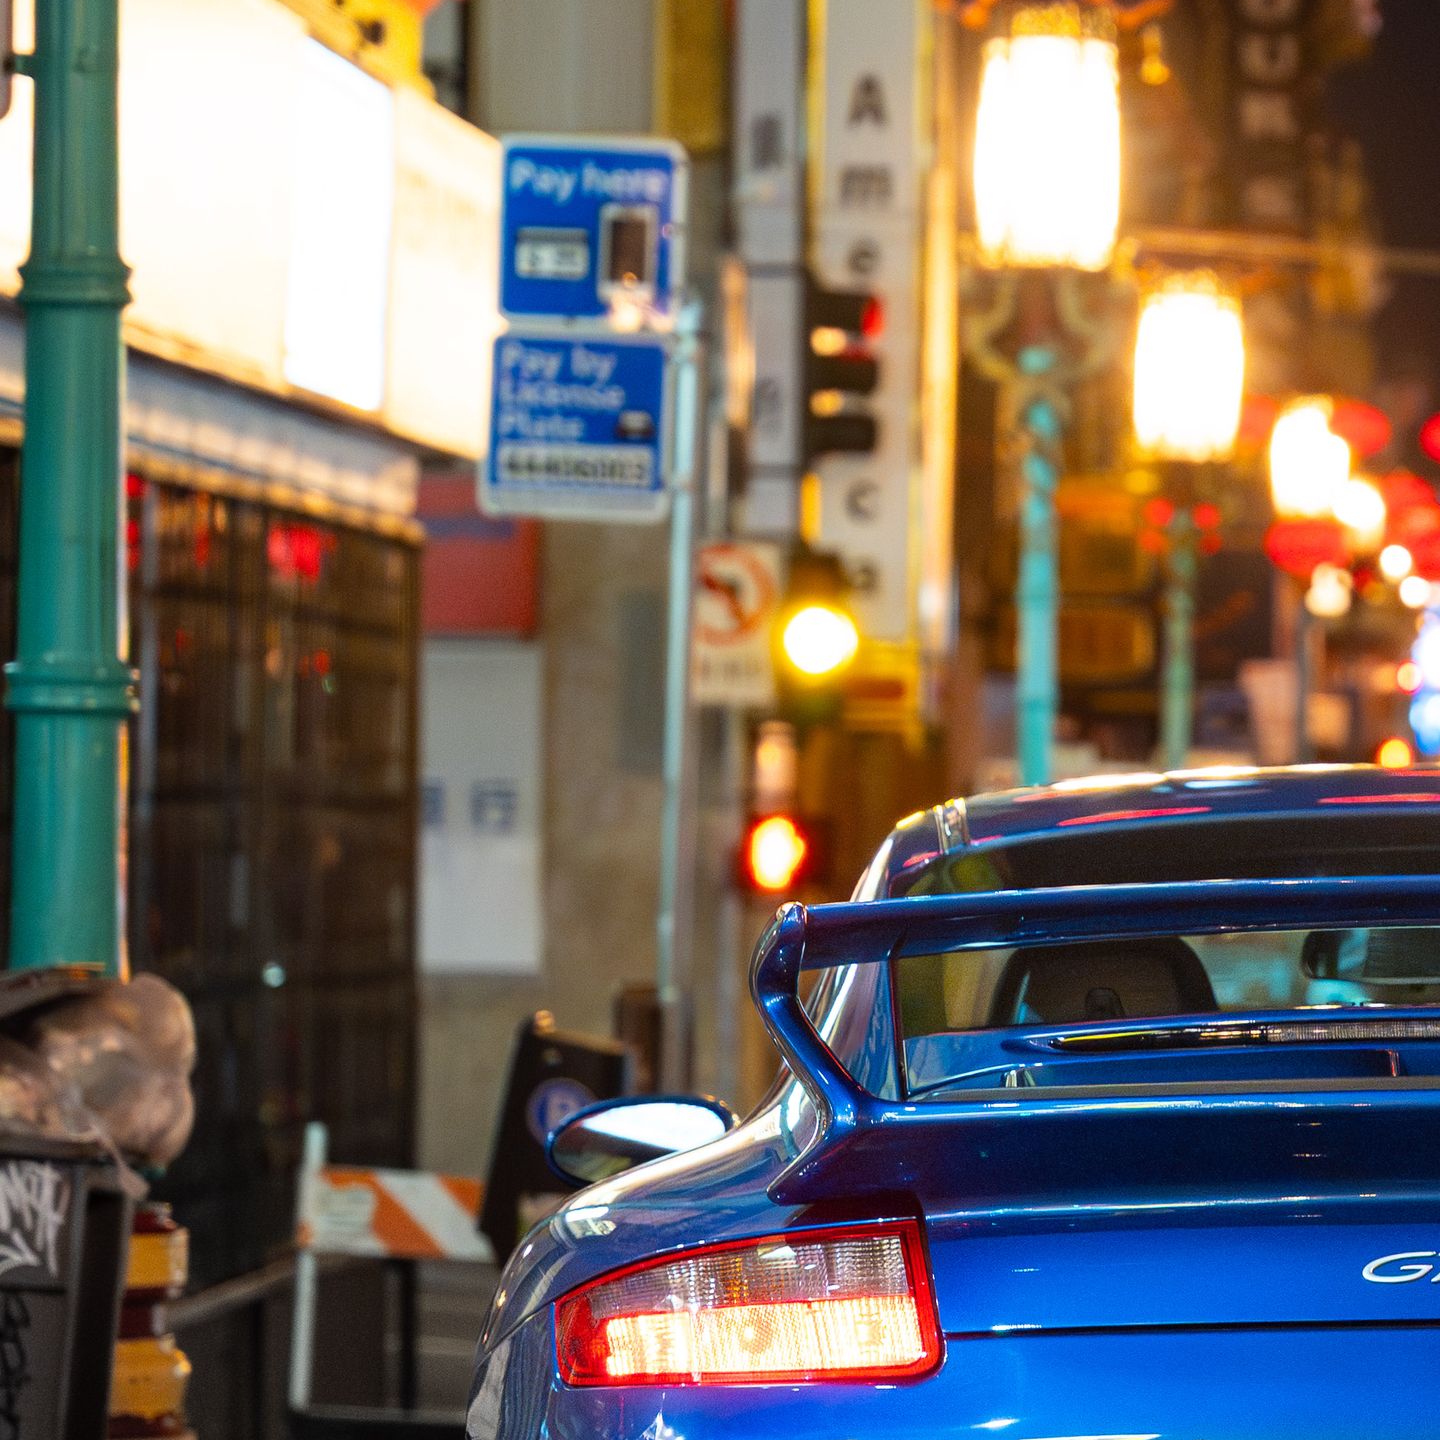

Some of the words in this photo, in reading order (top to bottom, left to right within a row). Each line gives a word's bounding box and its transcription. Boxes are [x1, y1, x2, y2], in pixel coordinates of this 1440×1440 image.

[509, 157, 577, 205] Pay
[581, 160, 669, 198] here
[839, 74, 892, 594] Ameca
[501, 343, 563, 380] Pay
[570, 343, 618, 386] by
[499, 381, 626, 409] License
